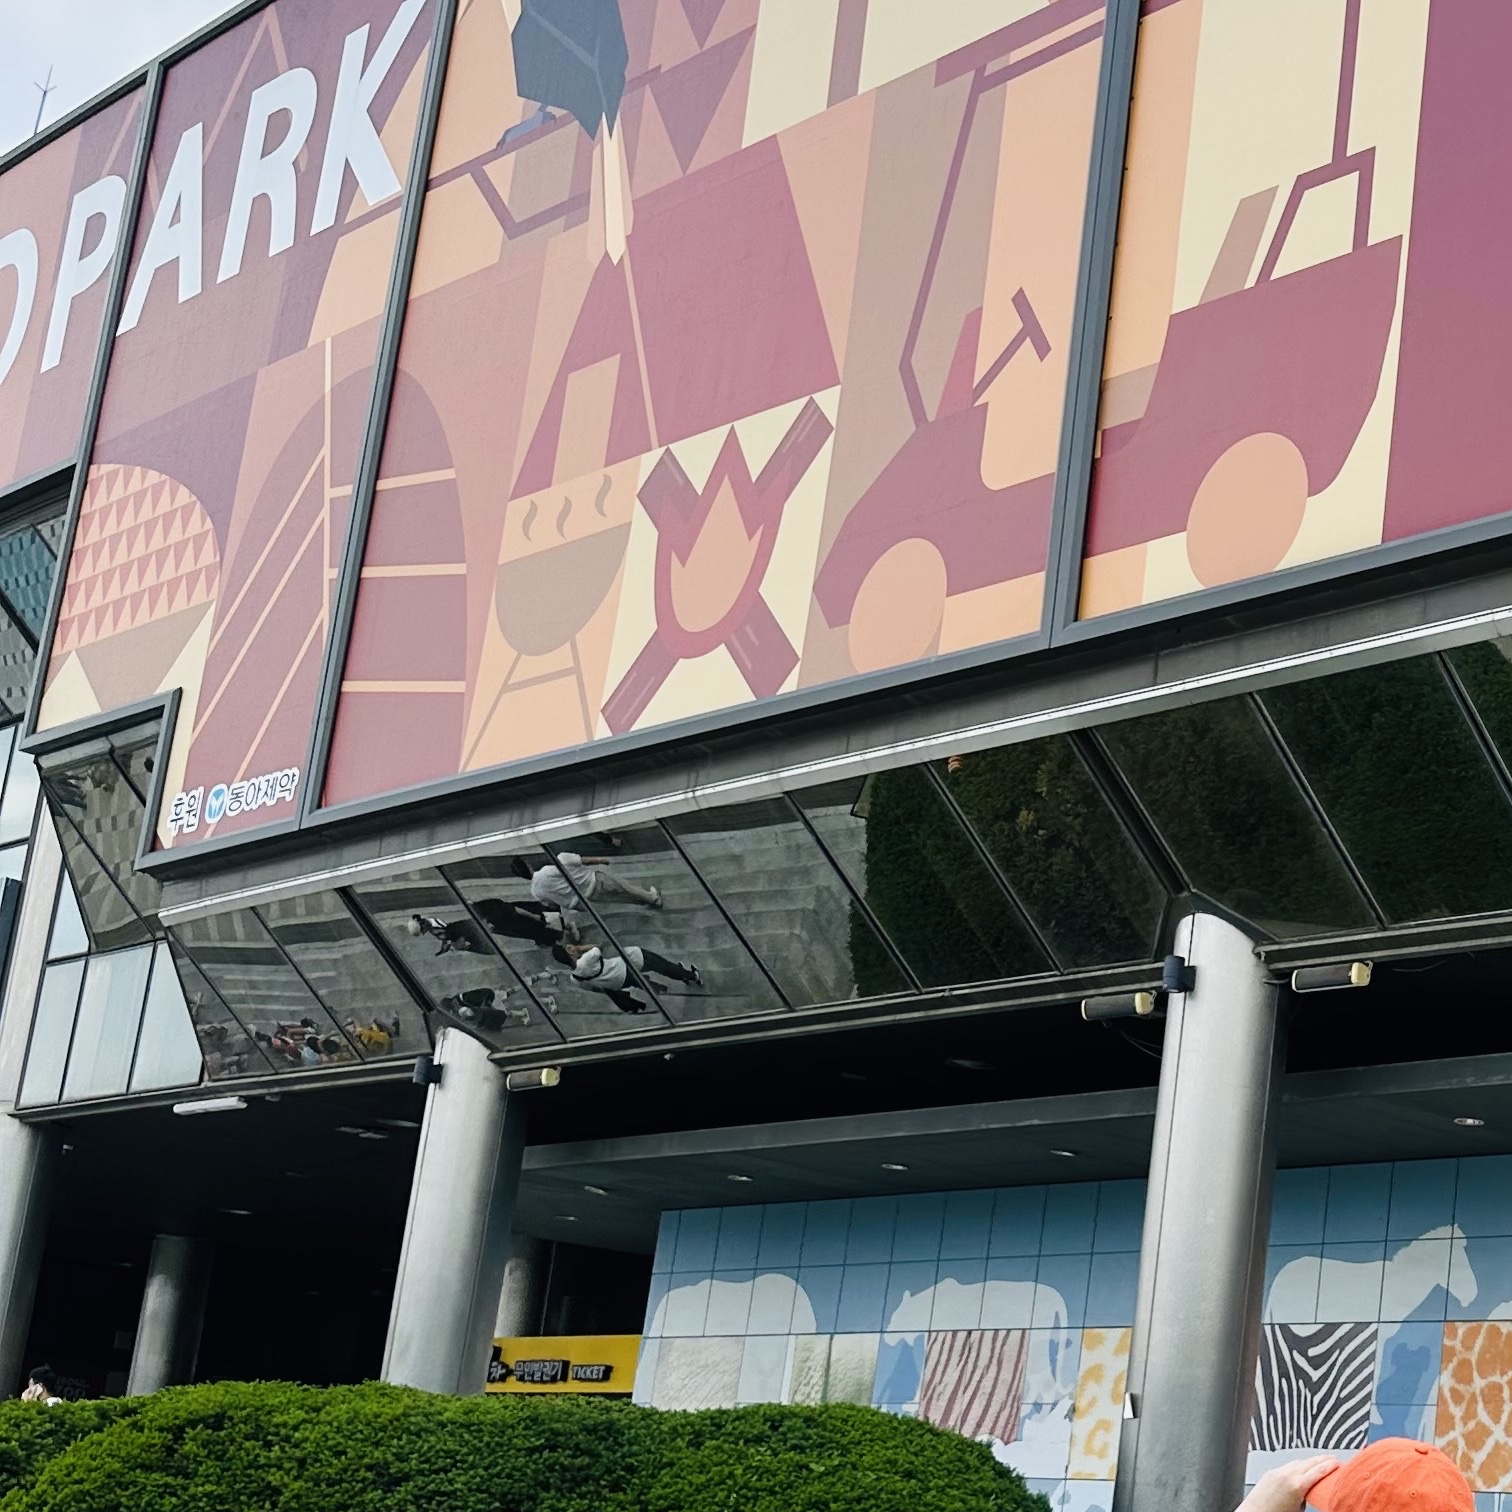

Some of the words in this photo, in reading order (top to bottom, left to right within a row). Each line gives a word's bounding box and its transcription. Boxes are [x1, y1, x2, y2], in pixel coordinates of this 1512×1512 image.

[170, 784, 204, 831] 후원
[229, 771, 297, 812] 동아제약
[513, 1361, 563, 1381] 무인발권기
[572, 1366, 605, 1380] TICKET
